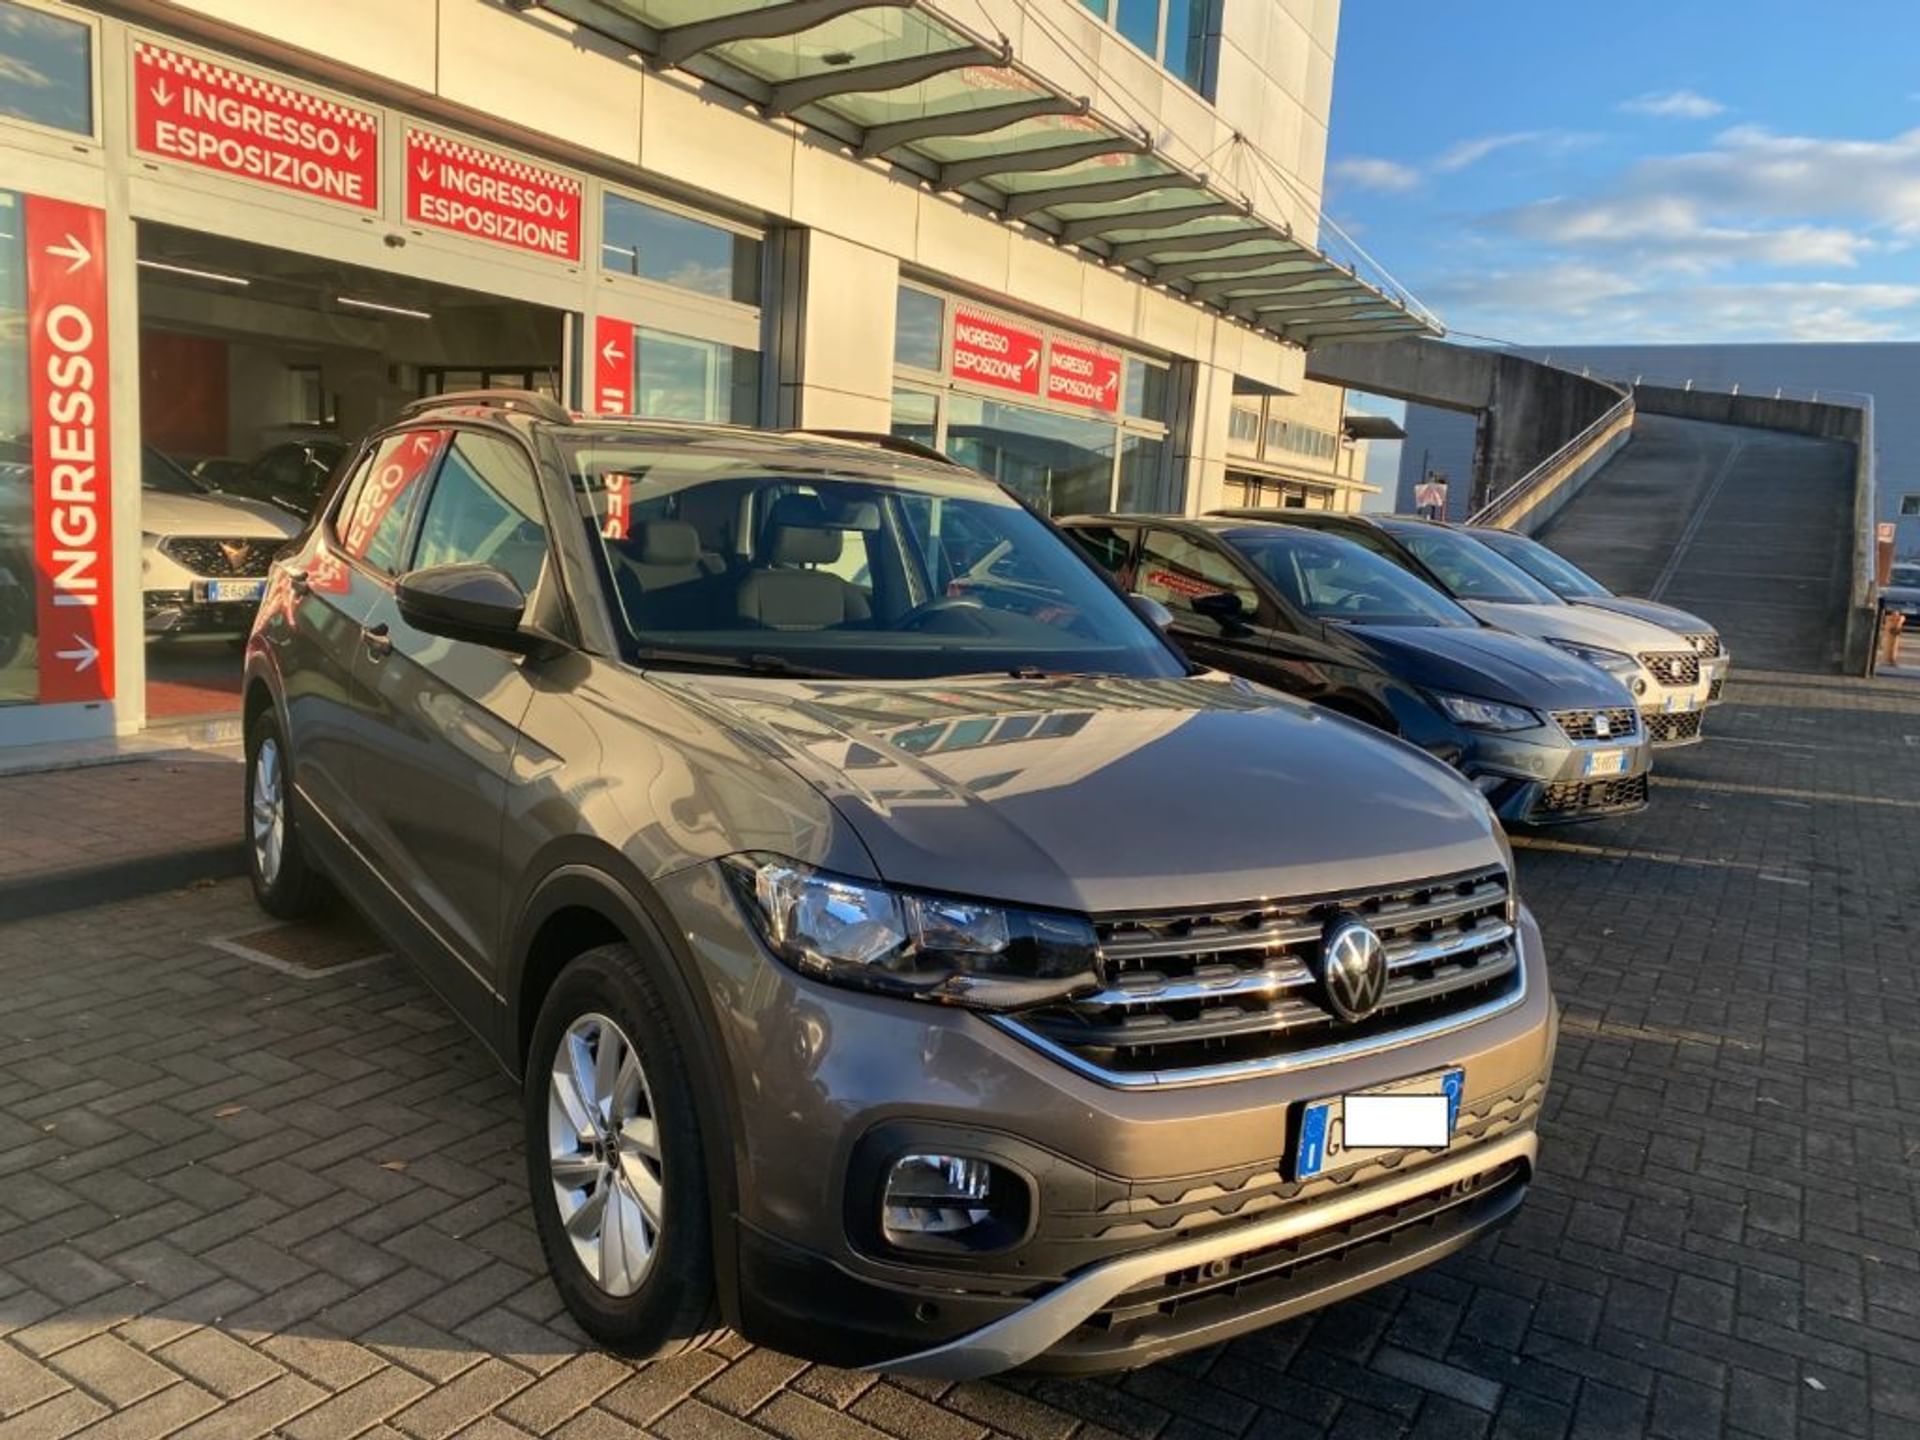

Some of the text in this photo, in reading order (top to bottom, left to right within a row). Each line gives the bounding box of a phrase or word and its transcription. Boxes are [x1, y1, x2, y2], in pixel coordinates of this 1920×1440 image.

[183, 86, 340, 156] INGRESSO
[156, 120, 363, 200] ESPOSIZIONE
[440, 164, 554, 216] INGRESSO
[420, 193, 569, 254] ESPOSIZIONE
[956, 324, 1009, 353] INGRESSO
[1052, 352, 1094, 377] INGRESSO
[955, 350, 1021, 383] ESPOSIZIONE
[1050, 376, 1104, 401] ESPOSIZIONE
[46, 304, 99, 606] INGRESSO
